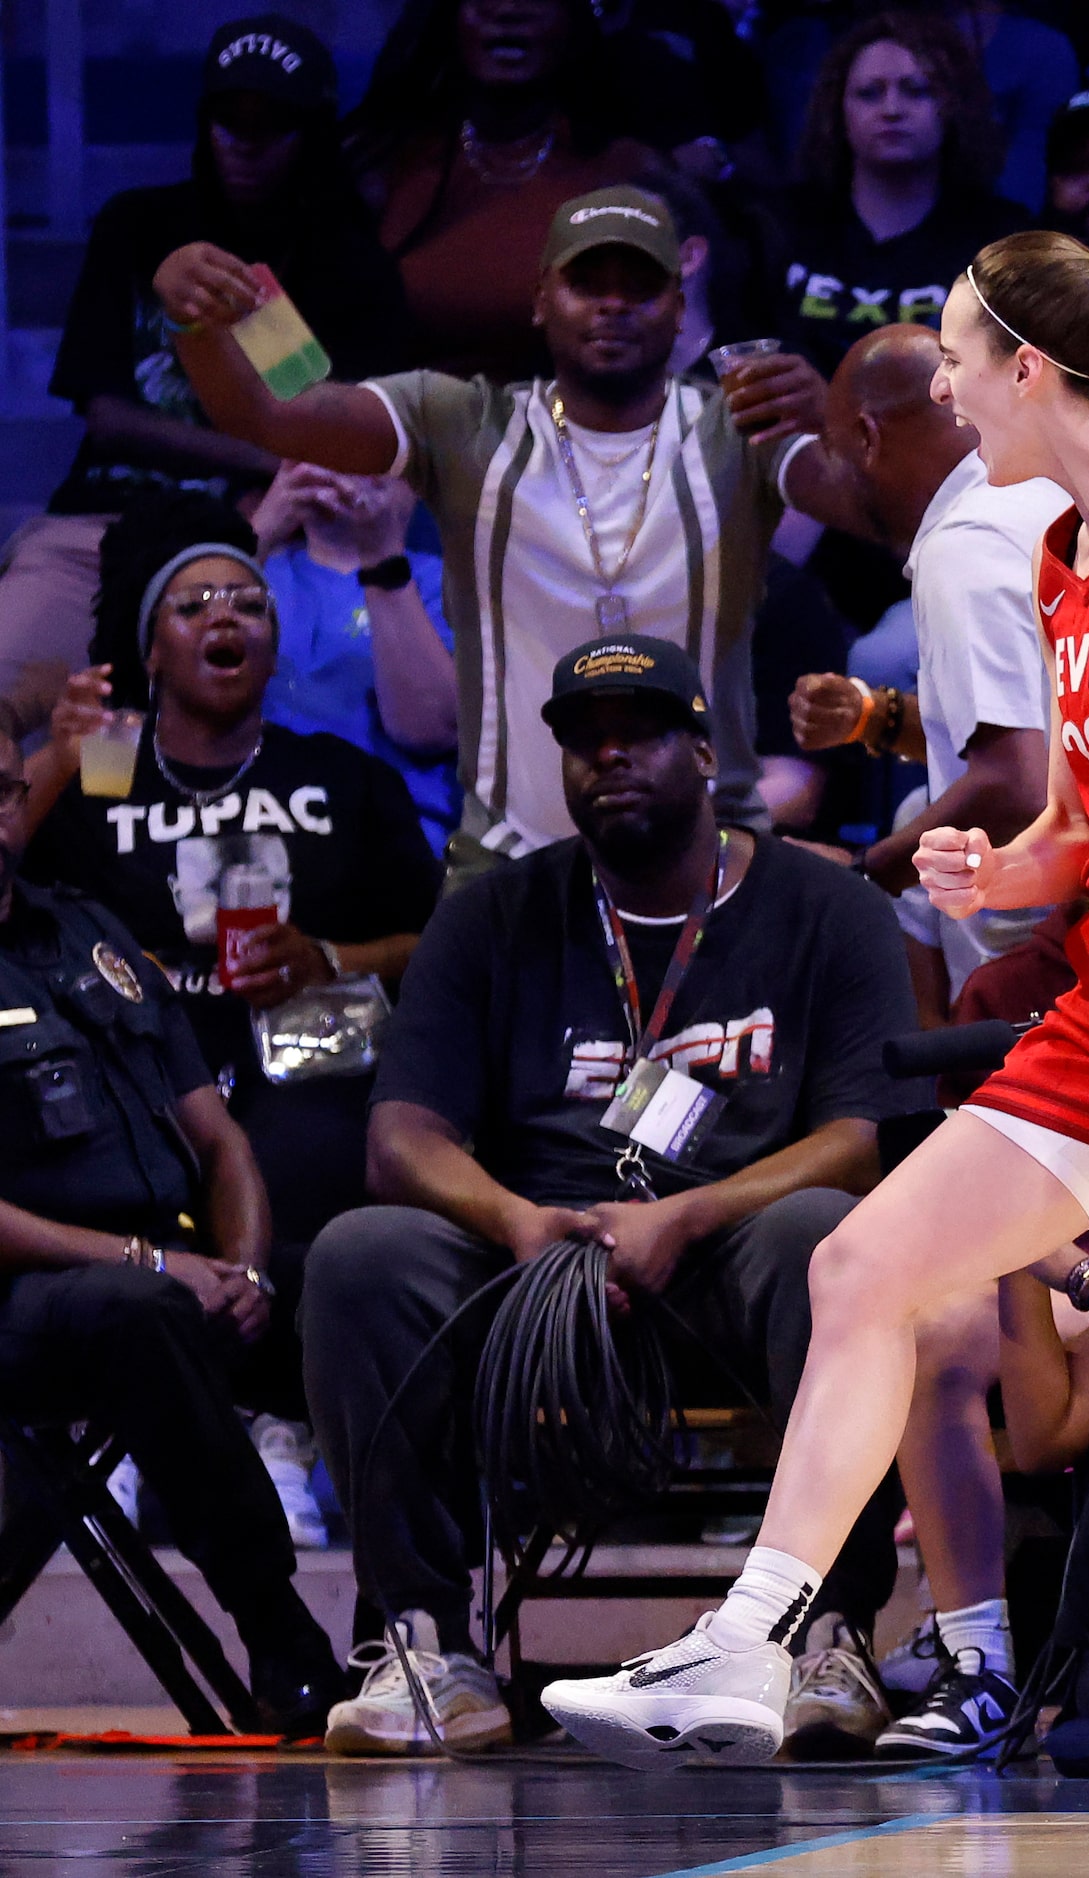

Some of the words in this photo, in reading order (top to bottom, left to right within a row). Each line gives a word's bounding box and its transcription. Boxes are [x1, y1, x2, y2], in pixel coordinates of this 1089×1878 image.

[574, 653, 655, 674] Championship
[590, 645, 635, 658] NATIONAL
[106, 785, 334, 854] TUPAC
[669, 1094, 708, 1153] BROADCAST
